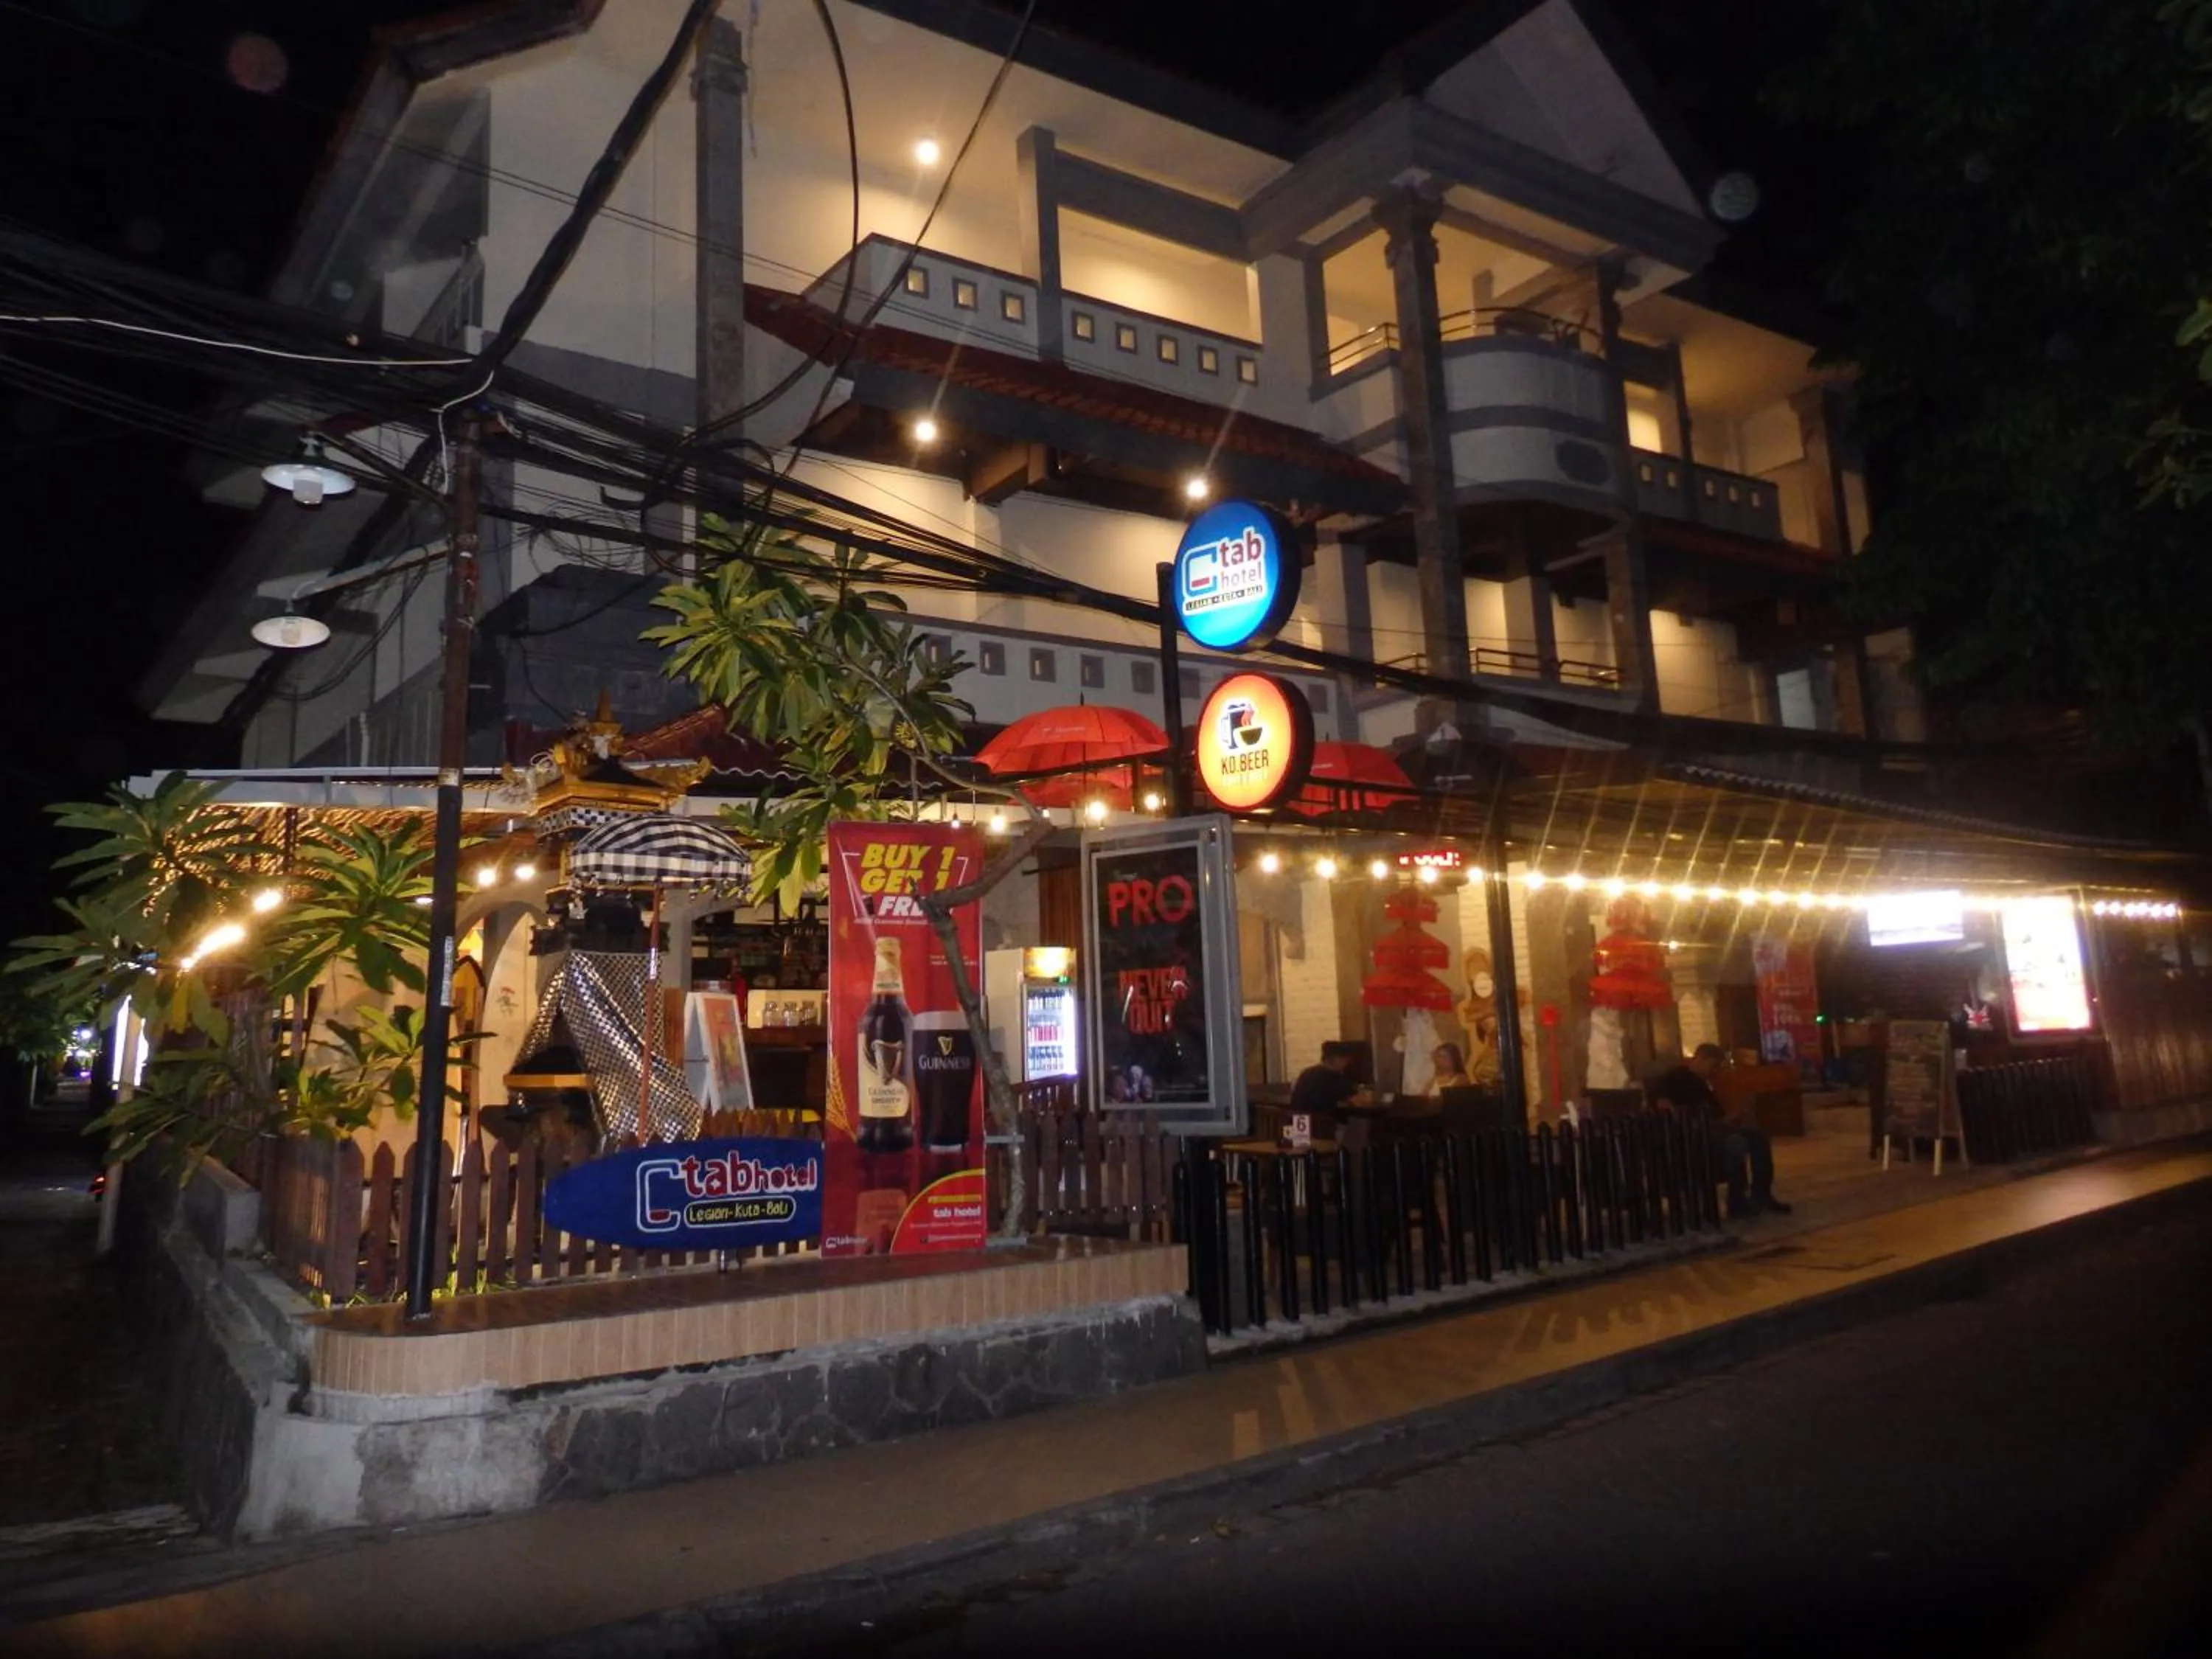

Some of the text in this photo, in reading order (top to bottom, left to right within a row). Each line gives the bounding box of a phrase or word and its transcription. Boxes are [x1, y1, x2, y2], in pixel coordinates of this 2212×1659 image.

[1219, 529, 1262, 568] tab
[1221, 561, 1262, 589] hotel
[860, 843, 956, 870] BUY 1
[860, 868, 950, 894] GET 1
[1107, 874, 1195, 928] PRO
[1117, 967, 1189, 1003] NEVER
[1128, 999, 1176, 1034] QUIT
[1296, 1116, 1307, 1133] 6
